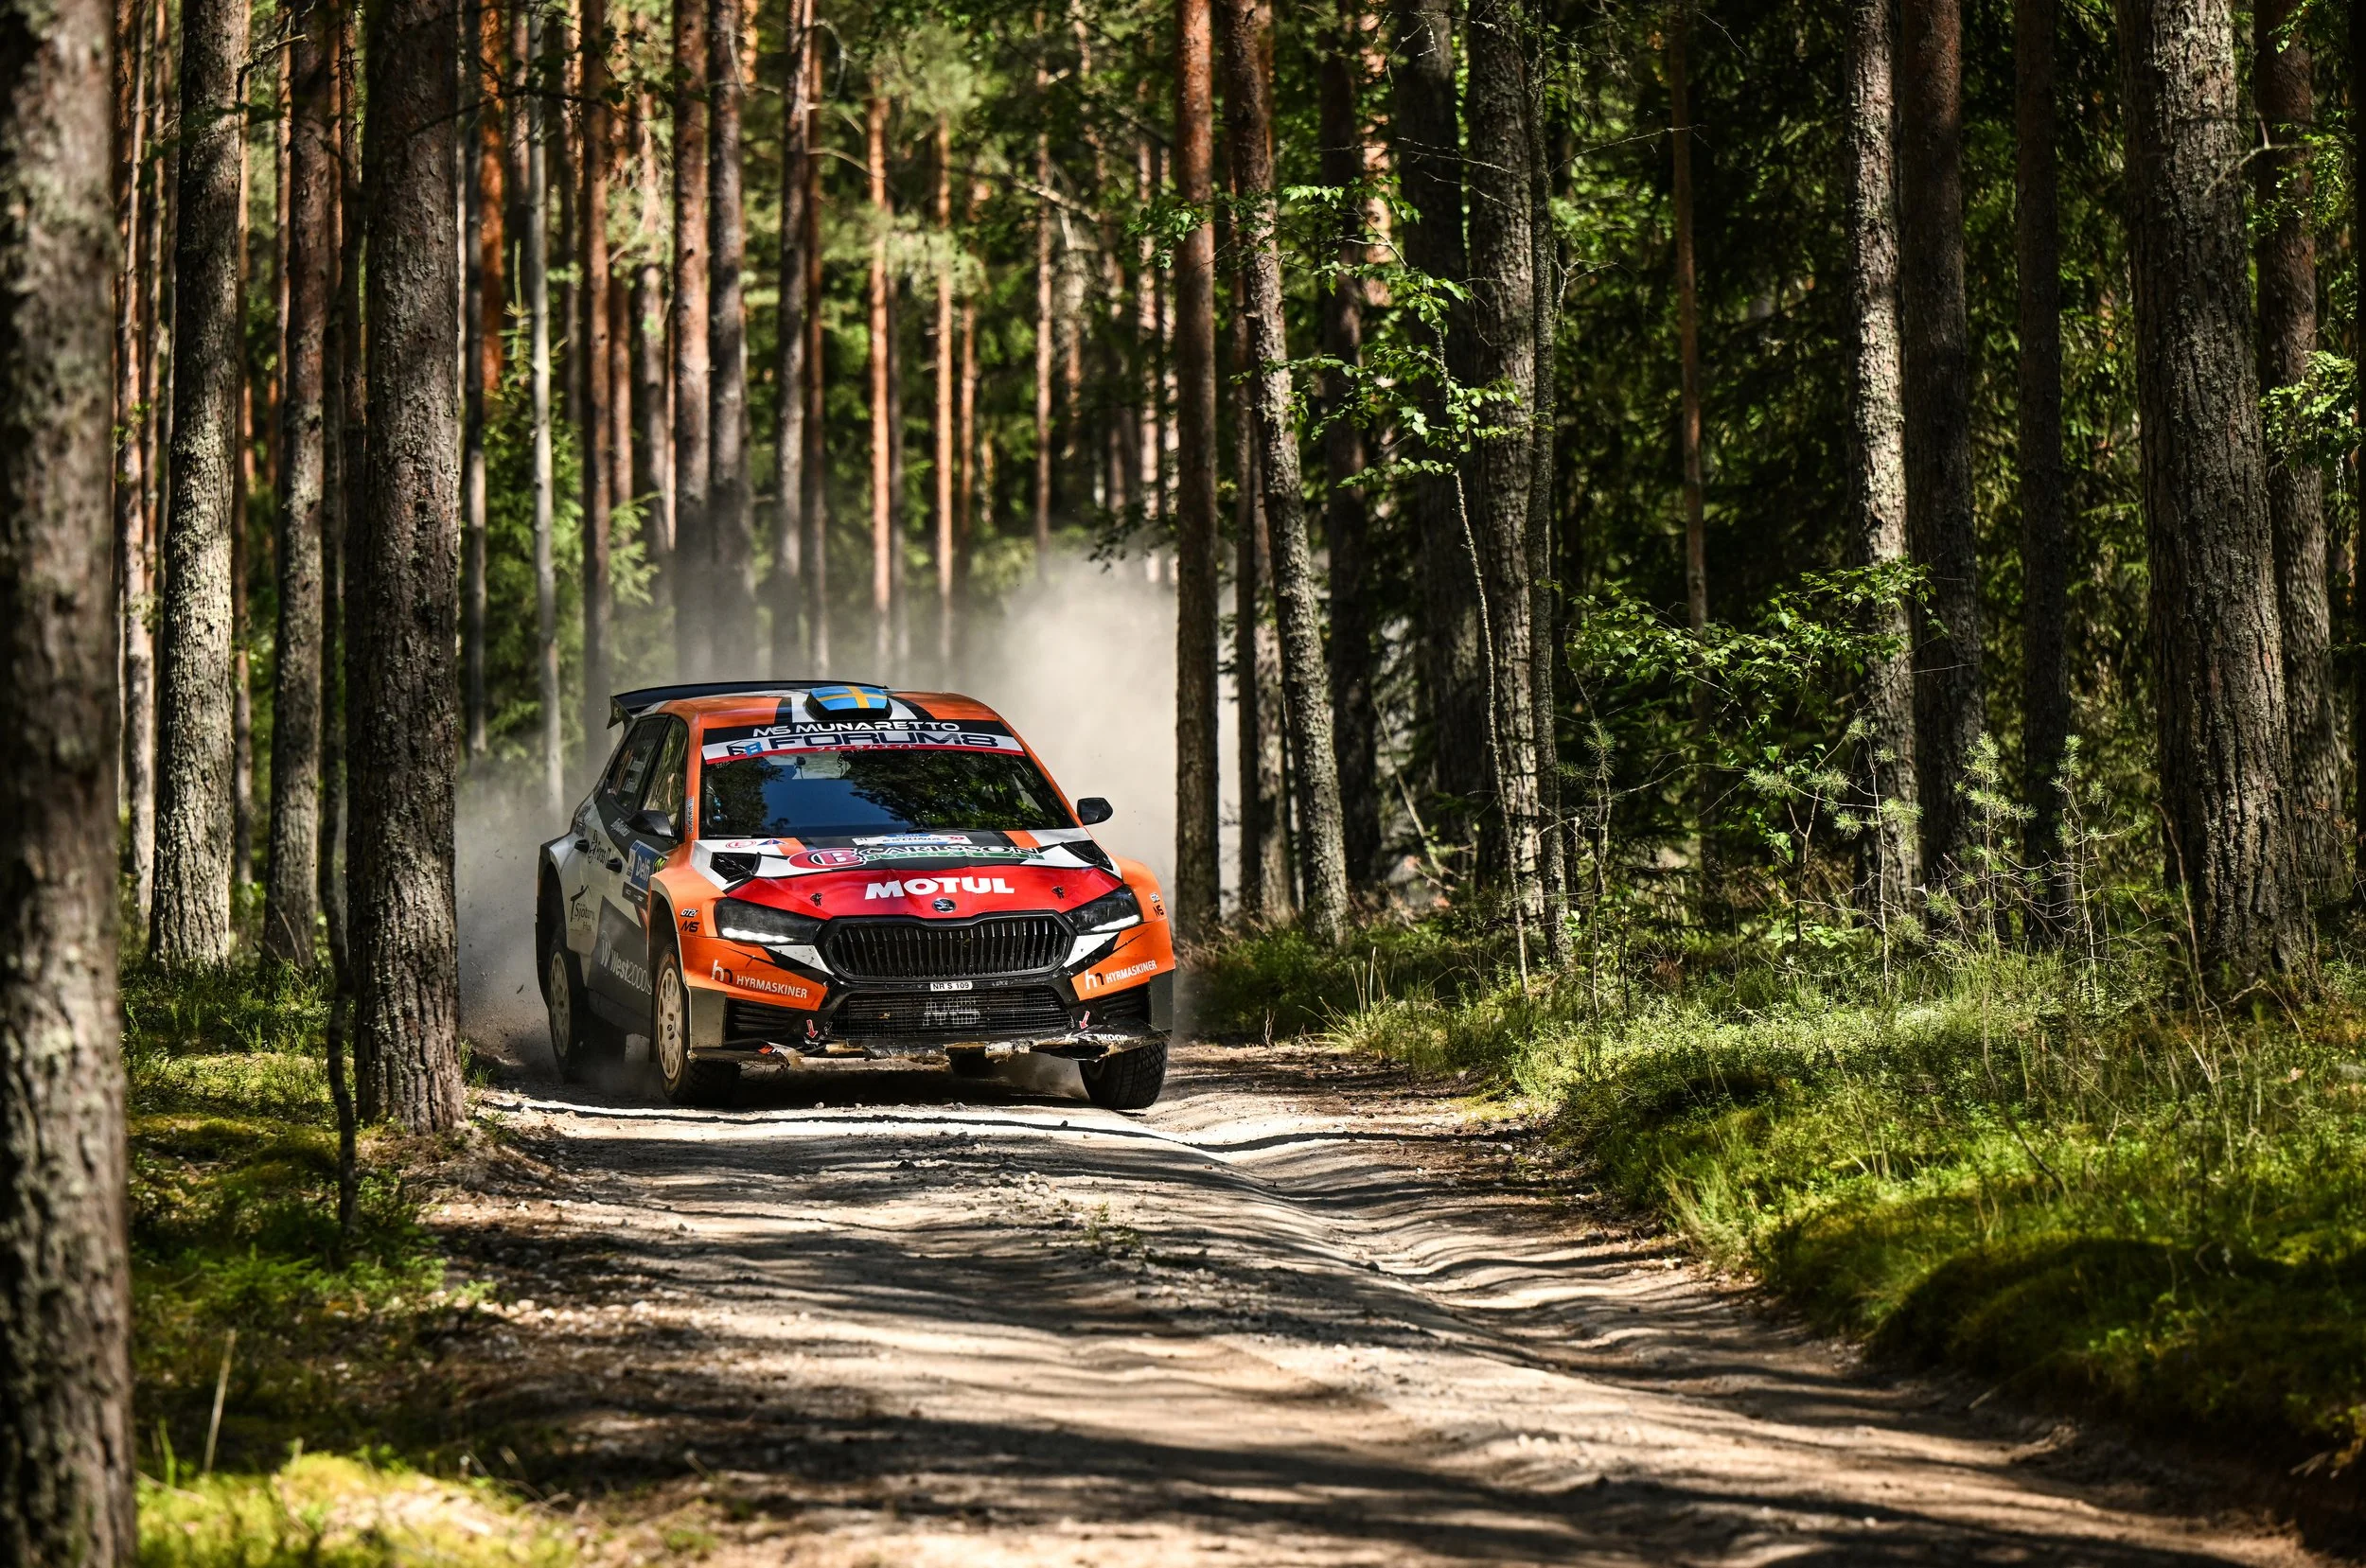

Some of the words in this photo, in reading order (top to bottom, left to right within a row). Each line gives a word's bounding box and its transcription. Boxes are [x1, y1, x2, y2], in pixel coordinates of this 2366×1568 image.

[753, 725, 791, 737] MS
[796, 720, 960, 733] MUNARETTO
[768, 731, 998, 750] FORUM8
[858, 843, 1041, 856] CARLSSON
[635, 855, 651, 882] Delfi
[865, 876, 1015, 900] MOTUL
[680, 920, 700, 933] MS
[1105, 960, 1157, 984] HYRMASKINER
[736, 975, 808, 999] HYRMASKINER
